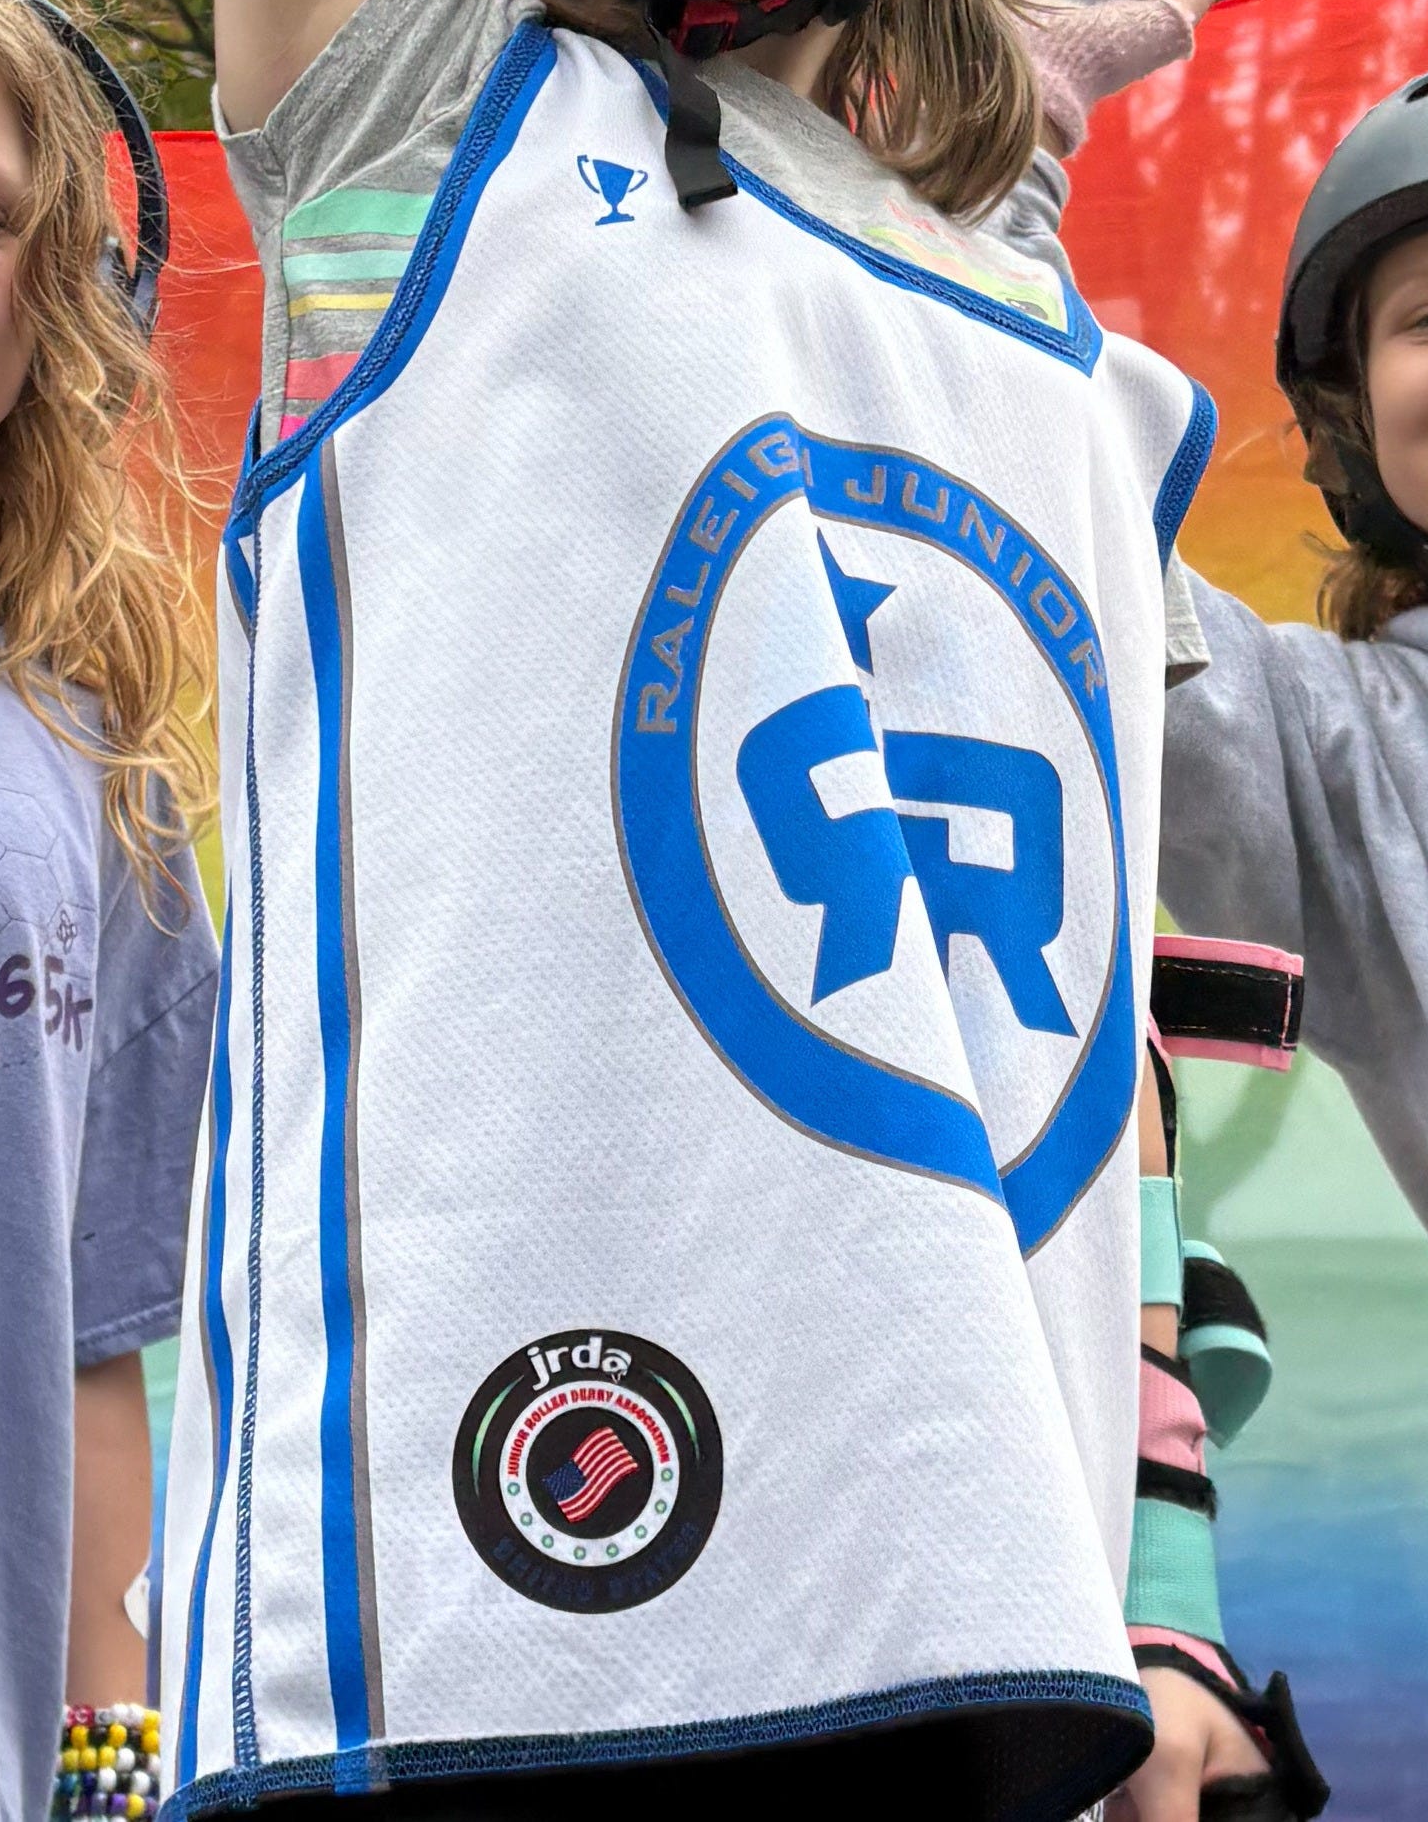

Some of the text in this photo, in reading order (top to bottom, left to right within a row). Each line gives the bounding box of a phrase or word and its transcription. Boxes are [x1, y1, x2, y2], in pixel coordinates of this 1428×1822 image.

[844, 465, 1108, 700] JUNIOR
[526, 1335, 633, 1392] jrda
[507, 1430, 530, 1477] JUNIOR
[523, 1391, 569, 1431] ROLLER
